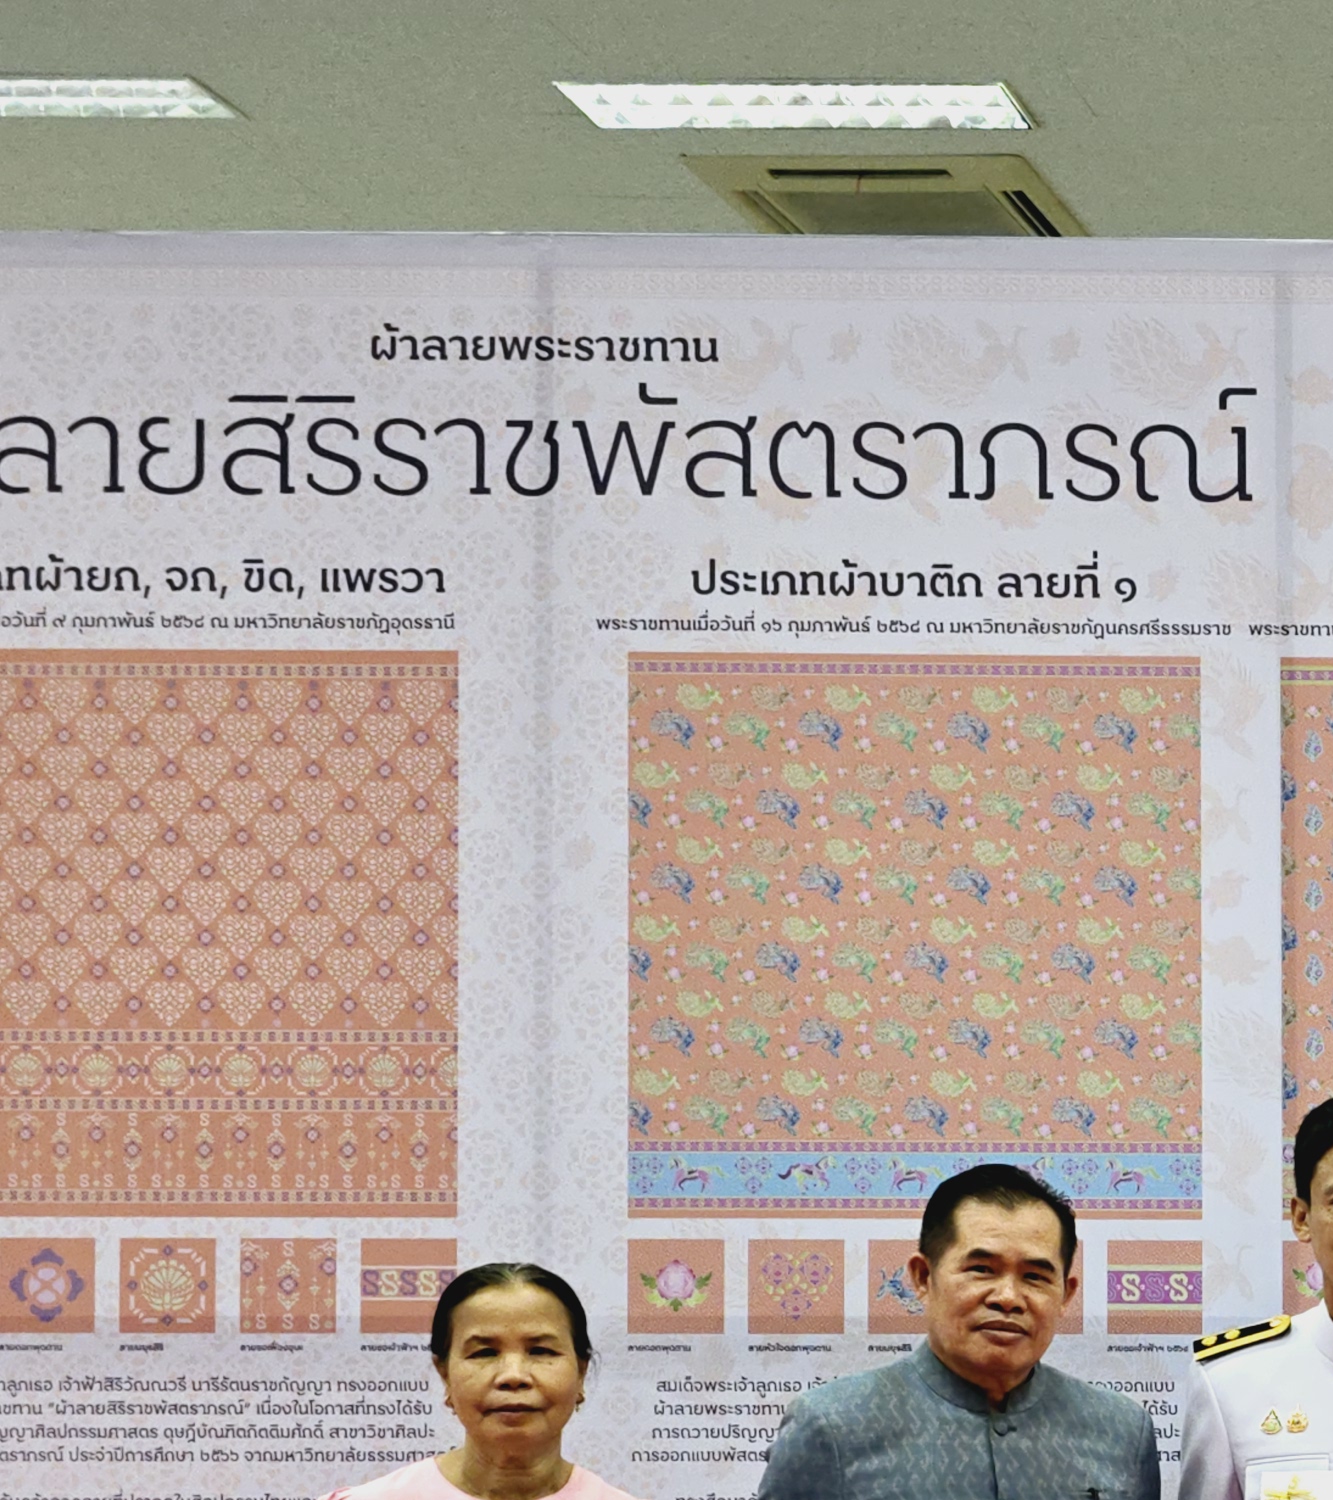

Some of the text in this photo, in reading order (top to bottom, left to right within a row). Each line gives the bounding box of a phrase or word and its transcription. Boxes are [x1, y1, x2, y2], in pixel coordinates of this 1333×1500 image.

[371, 323, 718, 362] ผ้าลายพระราชทาน
[165, 566, 228, 600] จก,
[242, 558, 305, 600] ขิด,
[320, 567, 446, 594] แพรวา
[691, 550, 1137, 603] ประเภทผ้าบาติก ลายที่ ๑
[71, 610, 156, 635] กุมภาพันธ์
[160, 614, 205, 629] ๒๕๖๘
[210, 616, 229, 629] ณ
[595, 609, 1232, 640] พระราชทานเมื่อวันที่ ๑๖ กุมภาพันธ์ ๒๕๖๘ ณ มหาวิทยาลัยราชภัฏนครศรีธรรมราช
[58, 1374, 187, 1392] เจ้าฟ้าสิริวัณณวรี
[336, 1380, 430, 1394] ทรงออกแบบ
[656, 1375, 803, 1399] สมเด็จพระเจ้าลูกเธอ
[328, 1422, 435, 1440] สาขาวิชาศิลปะ
[199, 1448, 240, 1463] ๒๕๖๖
